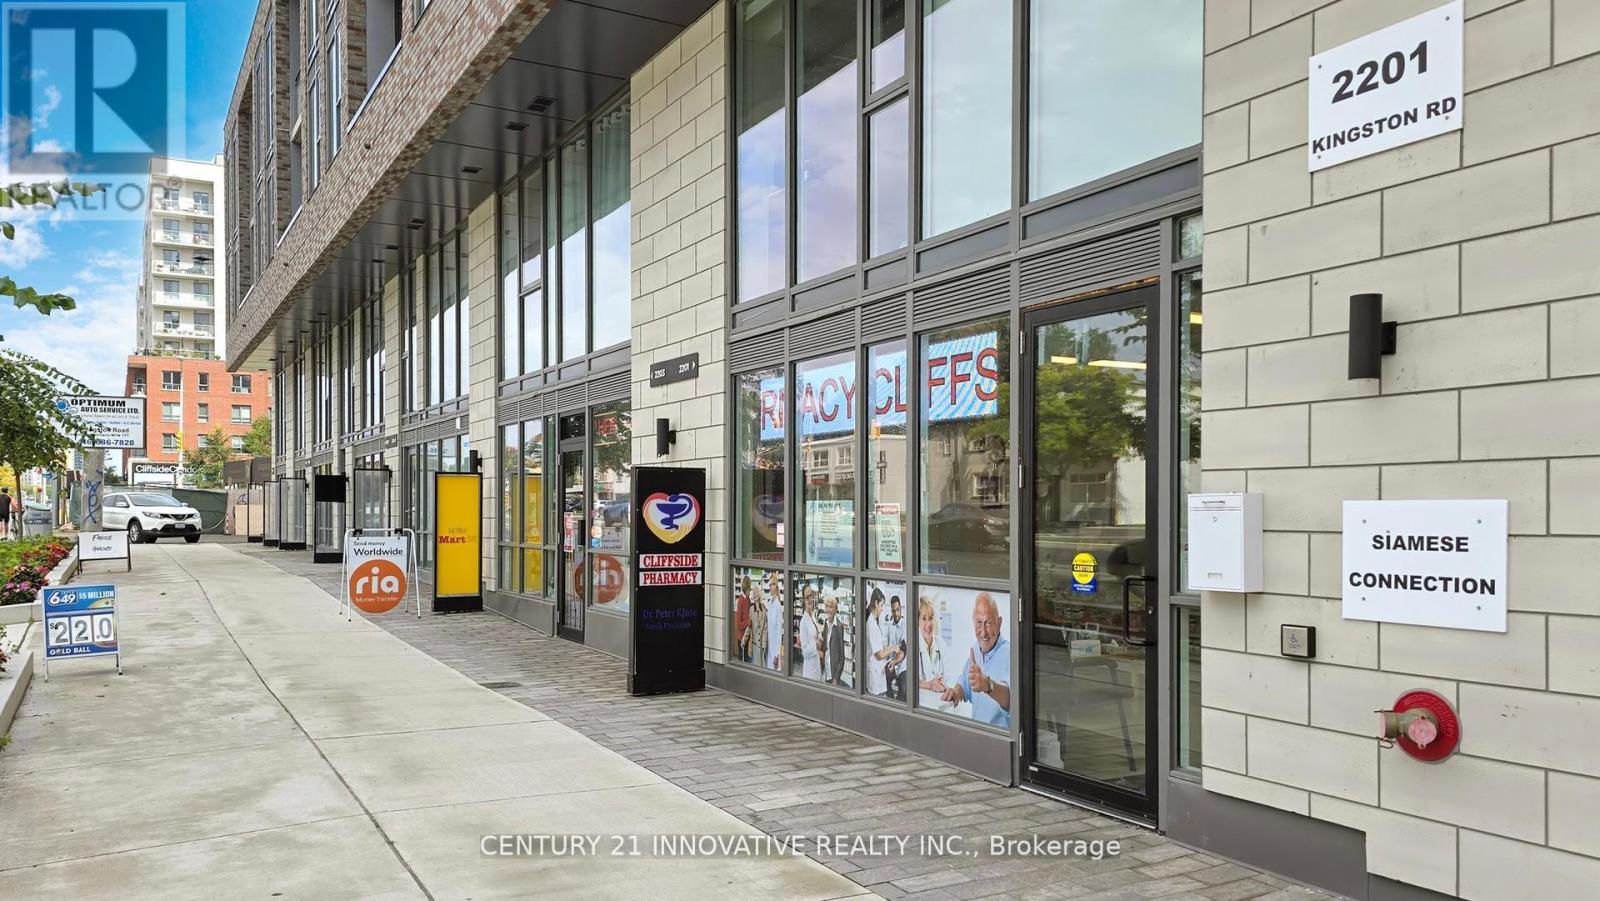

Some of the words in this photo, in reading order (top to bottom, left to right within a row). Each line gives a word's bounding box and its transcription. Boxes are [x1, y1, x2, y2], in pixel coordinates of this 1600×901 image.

[1331, 40, 1427, 104] 2201
[1312, 107, 1418, 154] KINGSTON
[1426, 96, 1456, 119] RD
[762, 375, 856, 430] RACY
[876, 347, 998, 415] CLFFS
[71, 398, 126, 407] OPTIMUM
[438, 535, 466, 544] Mart
[1371, 534, 1469, 553] SIAMESE
[354, 548, 403, 556] Worldwide
[643, 554, 698, 567] CLIFFSIDE
[356, 566, 399, 594] ria
[643, 571, 698, 584] PHARMACY
[1349, 572, 1496, 595] CONNECTION
[88, 590, 114, 599] MILLION
[73, 646, 92, 654] BALL
